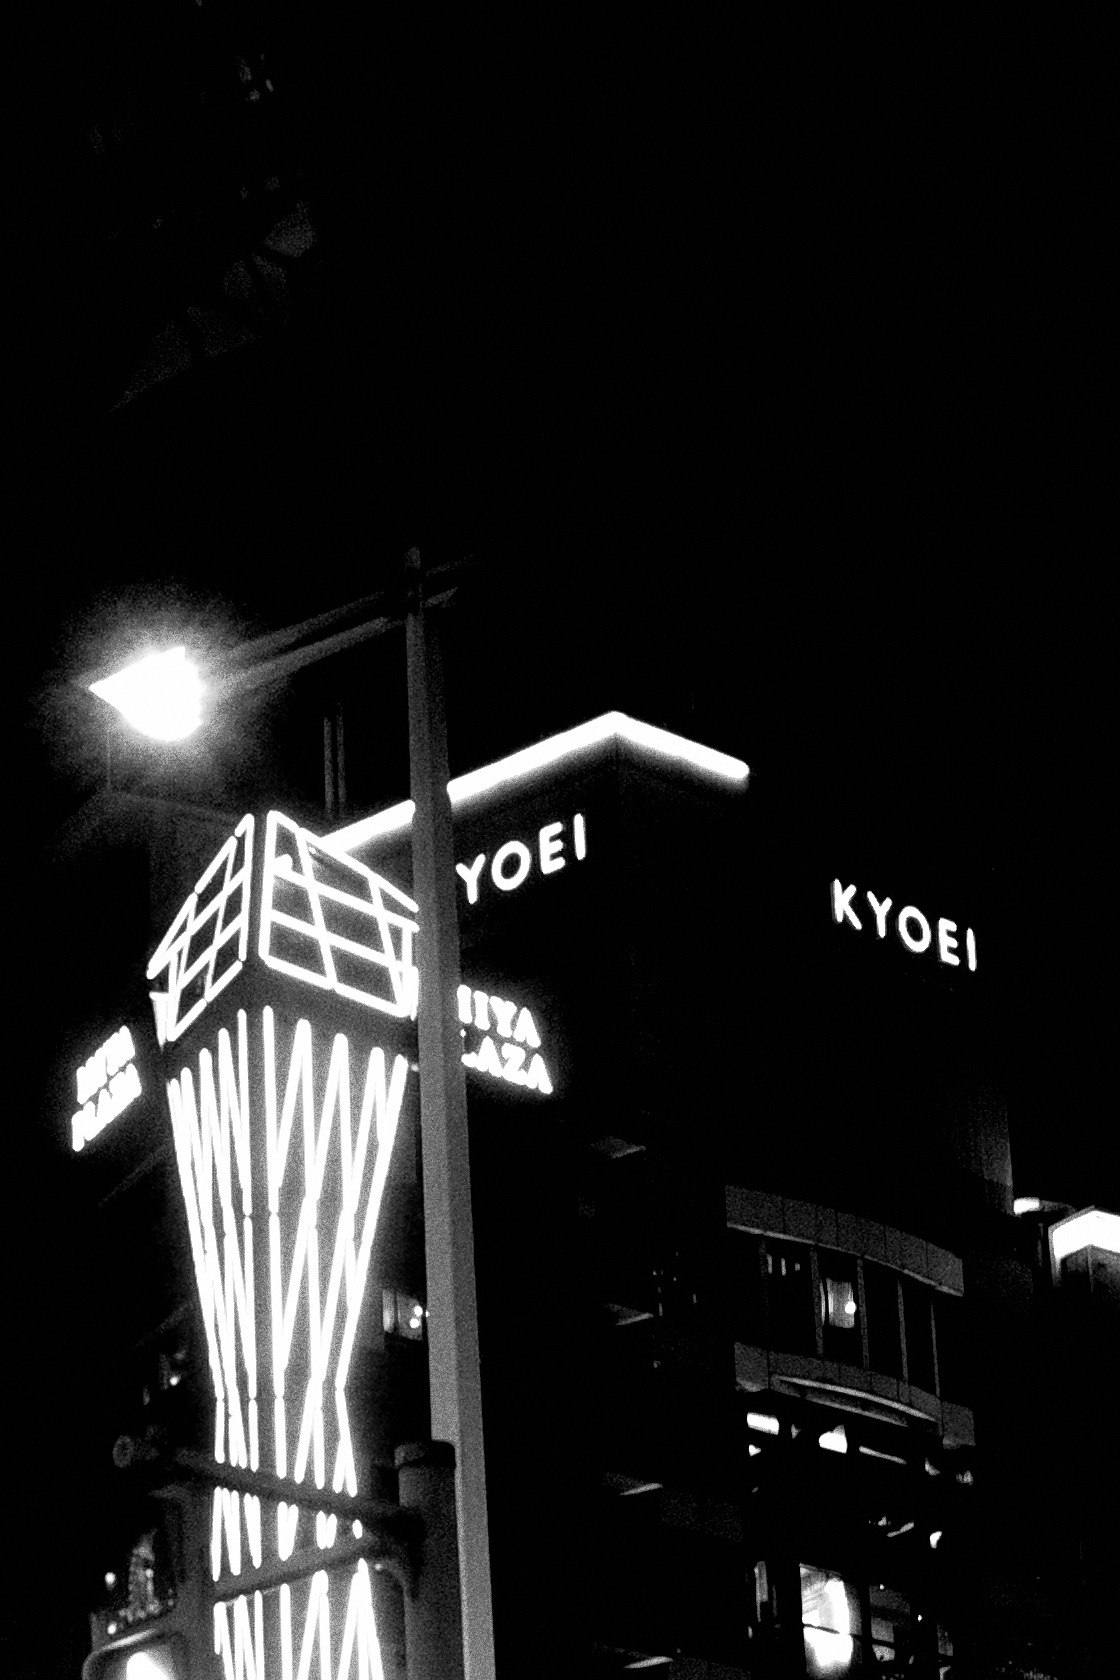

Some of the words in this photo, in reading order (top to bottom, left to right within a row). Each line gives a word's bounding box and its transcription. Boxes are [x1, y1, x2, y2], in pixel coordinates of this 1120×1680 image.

[455, 813, 586, 904] YOEI
[832, 878, 977, 971] KYOEI
[461, 1036, 553, 1095] LAZA
